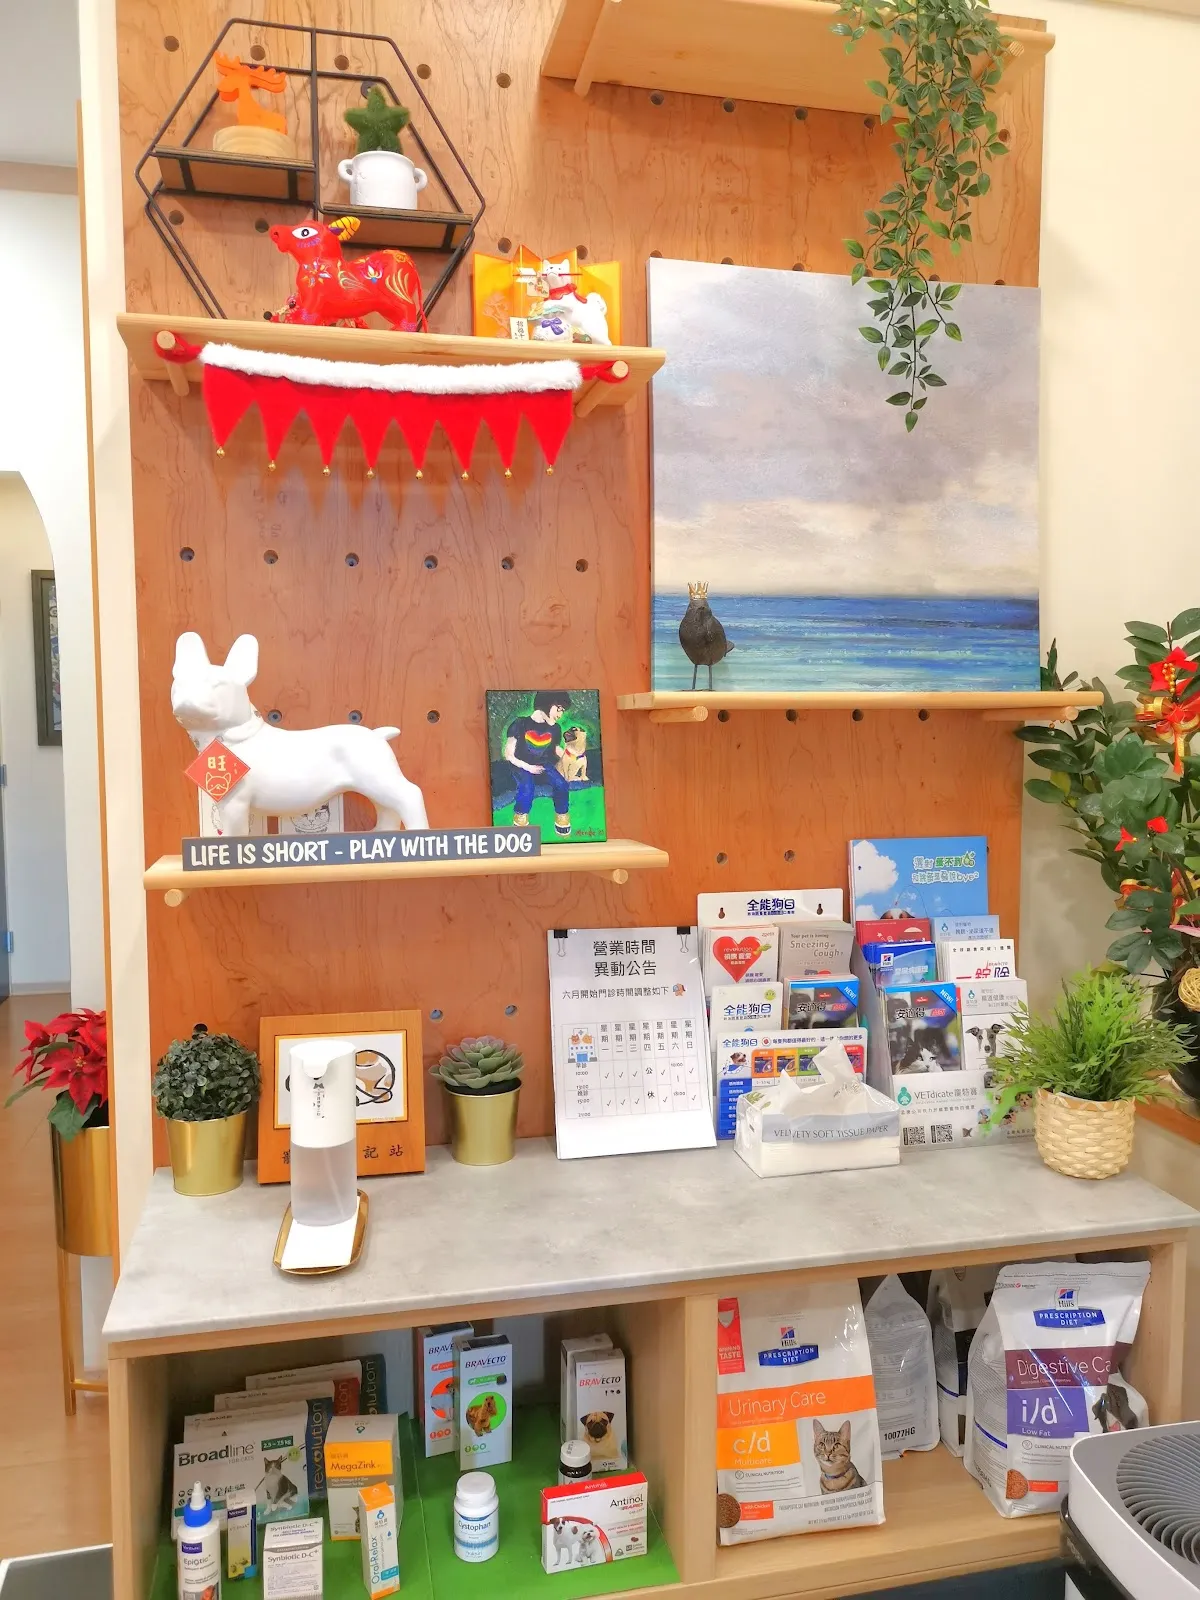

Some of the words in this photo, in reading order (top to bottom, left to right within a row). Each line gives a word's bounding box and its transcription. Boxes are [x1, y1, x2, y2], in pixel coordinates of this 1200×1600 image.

[207, 755, 226, 771] 旺
[190, 844, 230, 866] LIFE
[237, 845, 256, 864] IS
[261, 840, 329, 863] SHORT
[349, 837, 396, 860] PLAY
[401, 835, 448, 857] WITH
[453, 833, 488, 855] THE
[494, 832, 533, 853] DOG
[747, 898, 795, 911] 全能狗S
[593, 939, 656, 956] 營業時間
[790, 940, 830, 949] Sneezing
[594, 960, 657, 977] 異動公告
[562, 986, 669, 1000] 六月開始門診時間調整如下
[844, 986, 858, 1000] NEW!
[940, 989, 954, 1004] NEW!
[723, 1002, 772, 1016] 全能狗S
[600, 1024, 609, 1051] 星期一
[614, 1023, 623, 1053] 星期二
[628, 1022, 637, 1053] 星期三
[642, 1022, 651, 1052] 星期四
[656, 1021, 665, 1051] 星期五
[670, 1020, 679, 1050] 星期六
[684, 1019, 693, 1049] 星期日
[722, 1038, 758, 1048] 全能狗S
[914, 1090, 954, 1100] VETdicate
[774, 1128, 812, 1139] VELVETY
[813, 1129, 834, 1138] SOFT
[865, 1124, 889, 1134] PAPER
[1058, 1300, 1076, 1308] Hill's
[1039, 1311, 1098, 1319] PRESCRIPTION
[781, 1339, 798, 1347] Hill's
[719, 1351, 742, 1360] TASTE
[763, 1347, 815, 1359] PRESCRIPTION
[782, 1355, 799, 1364] DIET
[465, 1354, 507, 1370] BRAVECTO
[1017, 1356, 1089, 1380] Digestive
[579, 1375, 621, 1388] BRAVECTO
[728, 1397, 787, 1417] Urinary
[790, 1391, 826, 1408] Care
[1021, 1397, 1058, 1425] i/d
[884, 1426, 916, 1441] 10077HG
[1022, 1427, 1038, 1436] Low
[1039, 1429, 1051, 1437] Fat
[310, 1402, 323, 1490] revolution
[733, 1430, 771, 1455] c/d
[178, 1444, 254, 1467] Broadline
[331, 1460, 376, 1471] MegaZink
[610, 1494, 644, 1508] Antinol
[270, 1524, 301, 1532] Synbiotic
[268, 1554, 300, 1563] Synbiotic
